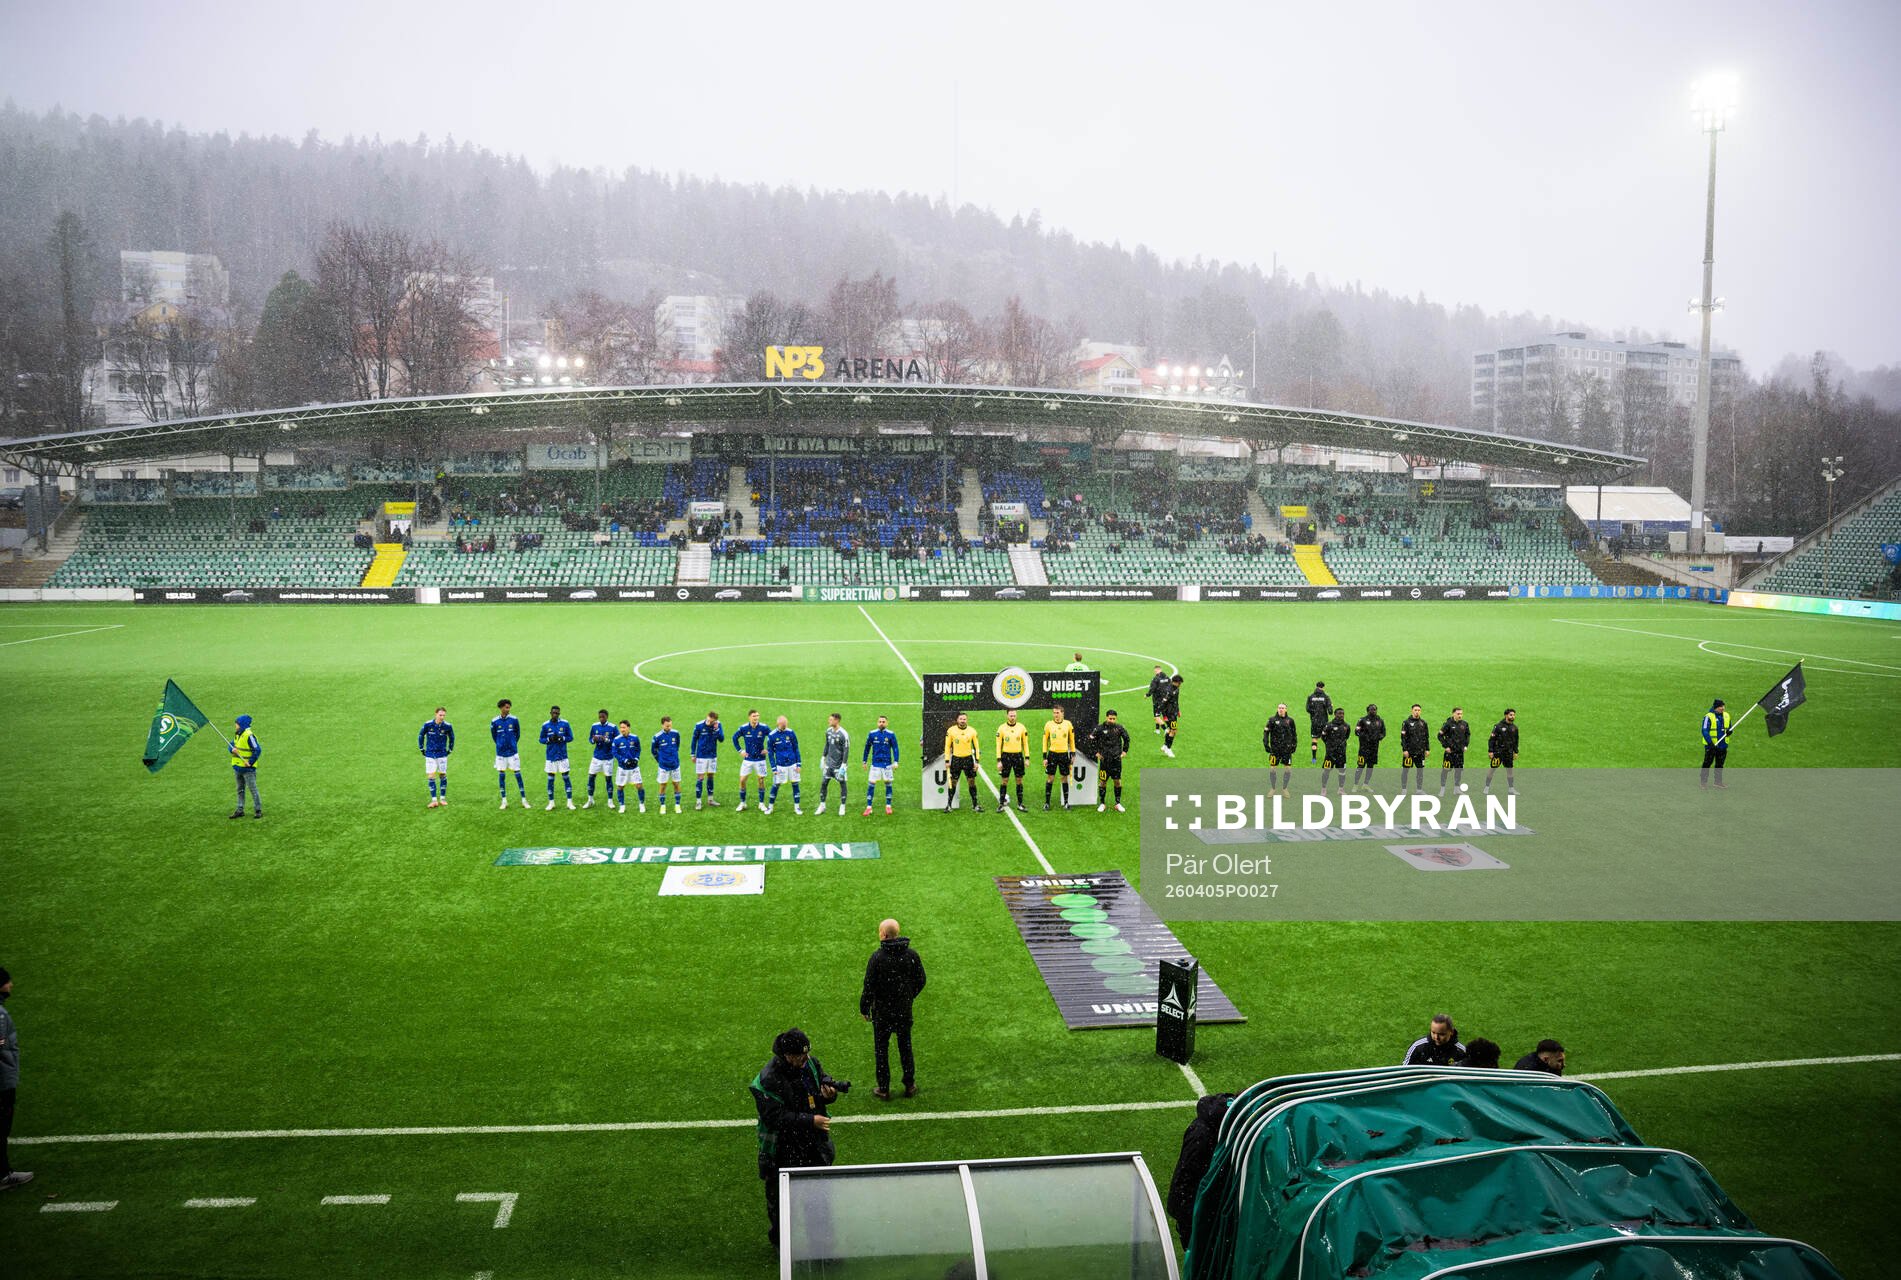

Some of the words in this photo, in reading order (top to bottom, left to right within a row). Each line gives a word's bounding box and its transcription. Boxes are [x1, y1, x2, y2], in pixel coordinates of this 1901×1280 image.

[766, 345, 825, 379] NP3
[834, 358, 922, 379] ARENA
[820, 587, 881, 601] SUPERETTAN
[933, 681, 983, 694] UNIBET
[1043, 679, 1091, 692] UNIBET
[934, 769, 947, 786] U
[1073, 766, 1086, 782] U
[586, 842, 852, 864] SUPERETTAN
[1019, 877, 1102, 888] UNIBET
[1091, 1001, 1158, 1015] UNIB
[1161, 1004, 1185, 1021] SELECT
